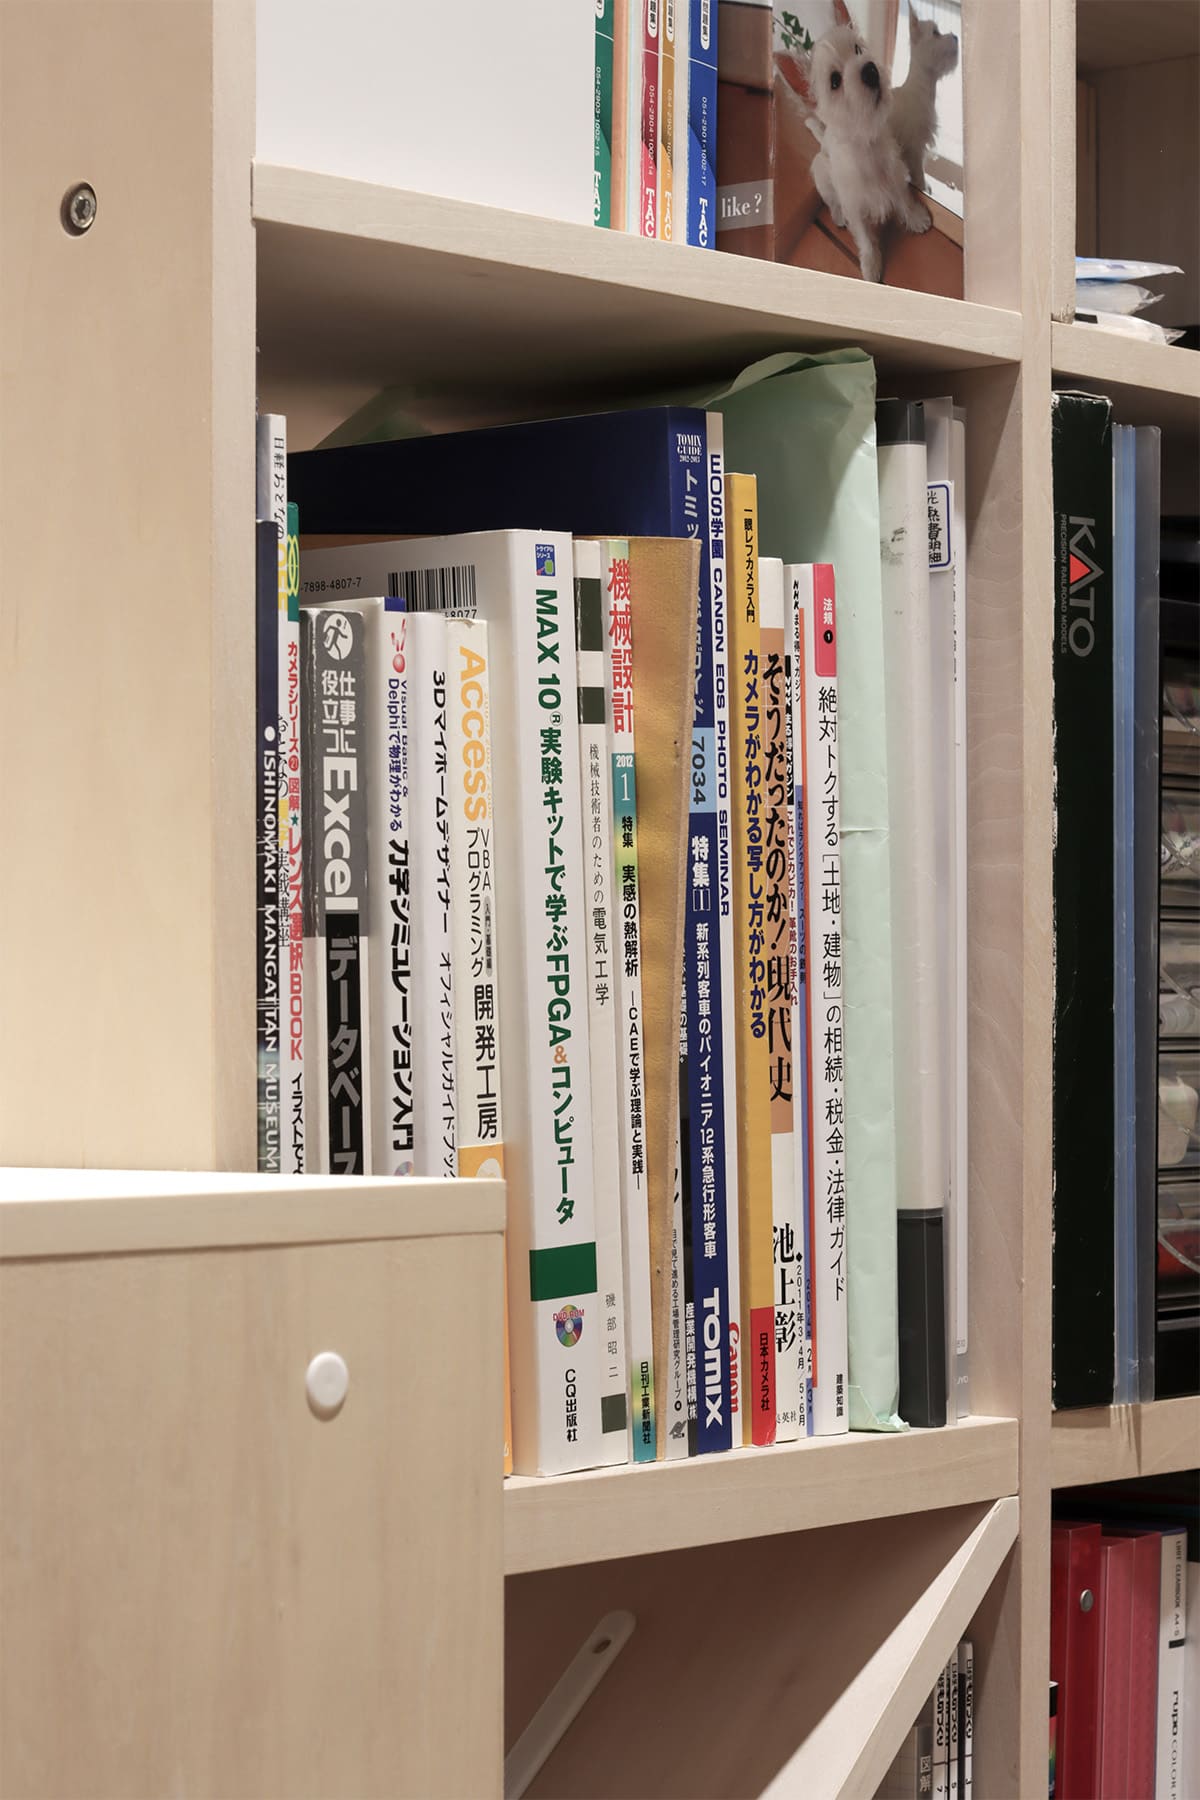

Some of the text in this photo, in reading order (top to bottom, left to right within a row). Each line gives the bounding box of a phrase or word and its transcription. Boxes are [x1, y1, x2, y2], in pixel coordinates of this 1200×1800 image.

[645, 187, 655, 238] TAC
[664, 190, 673, 240] TAC
[698, 197, 708, 248] TAC
[721, 196, 750, 219] like
[676, 445, 702, 457] GUIDE
[744, 508, 756, 623] 一眼レフカメラ入門
[1060, 514, 1068, 562] PRECISION
[535, 589, 560, 664] MAX
[823, 597, 833, 625] 法規
[1060, 564, 1068, 613] RAILROAD
[1069, 515, 1105, 657] KATO
[607, 558, 634, 733] 機械設計
[321, 669, 339, 754] 役立つ
[339, 669, 357, 754] 仕事に
[459, 645, 487, 822] Access
[388, 678, 402, 832] Delphiで物理がわかる
[402, 785, 409, 798] &
[615, 755, 634, 768] 2012
[620, 773, 631, 801] 1
[692, 735, 706, 805] 7034
[323, 756, 359, 911] Excel
[480, 828, 491, 891] VBA
[621, 815, 634, 848] 特集
[743, 649, 767, 1039] カメラがわかる写し方がわかる
[466, 827, 485, 978] プログラミング
[589, 743, 610, 1006] 機械技術者のための電気工学
[263, 750, 278, 1173] ISHINOMAKI MANGATTAN MUSEUM
[433, 670, 457, 1178] 3Dマイホームデザイナー オフィシャルガイドブッ
[622, 864, 639, 977] 実感の熱解析
[709, 454, 740, 1414] EOS学園 CANON EOS PHOTO SEMINAR Canon
[388, 839, 414, 1151] 力学シミュレーション入門
[474, 983, 498, 1140] 開発工房
[552, 1307, 585, 1323] DVD-ROM
[773, 1222, 796, 1353] 池上彰
[604, 1292, 618, 1378] 磯部昭二
[703, 1287, 723, 1429] TOMIX
[759, 1332, 770, 1411] 日本カメラ社
[564, 1368, 578, 1442] CQ出版社
[639, 1361, 651, 1444] 日刊工業新聞社
